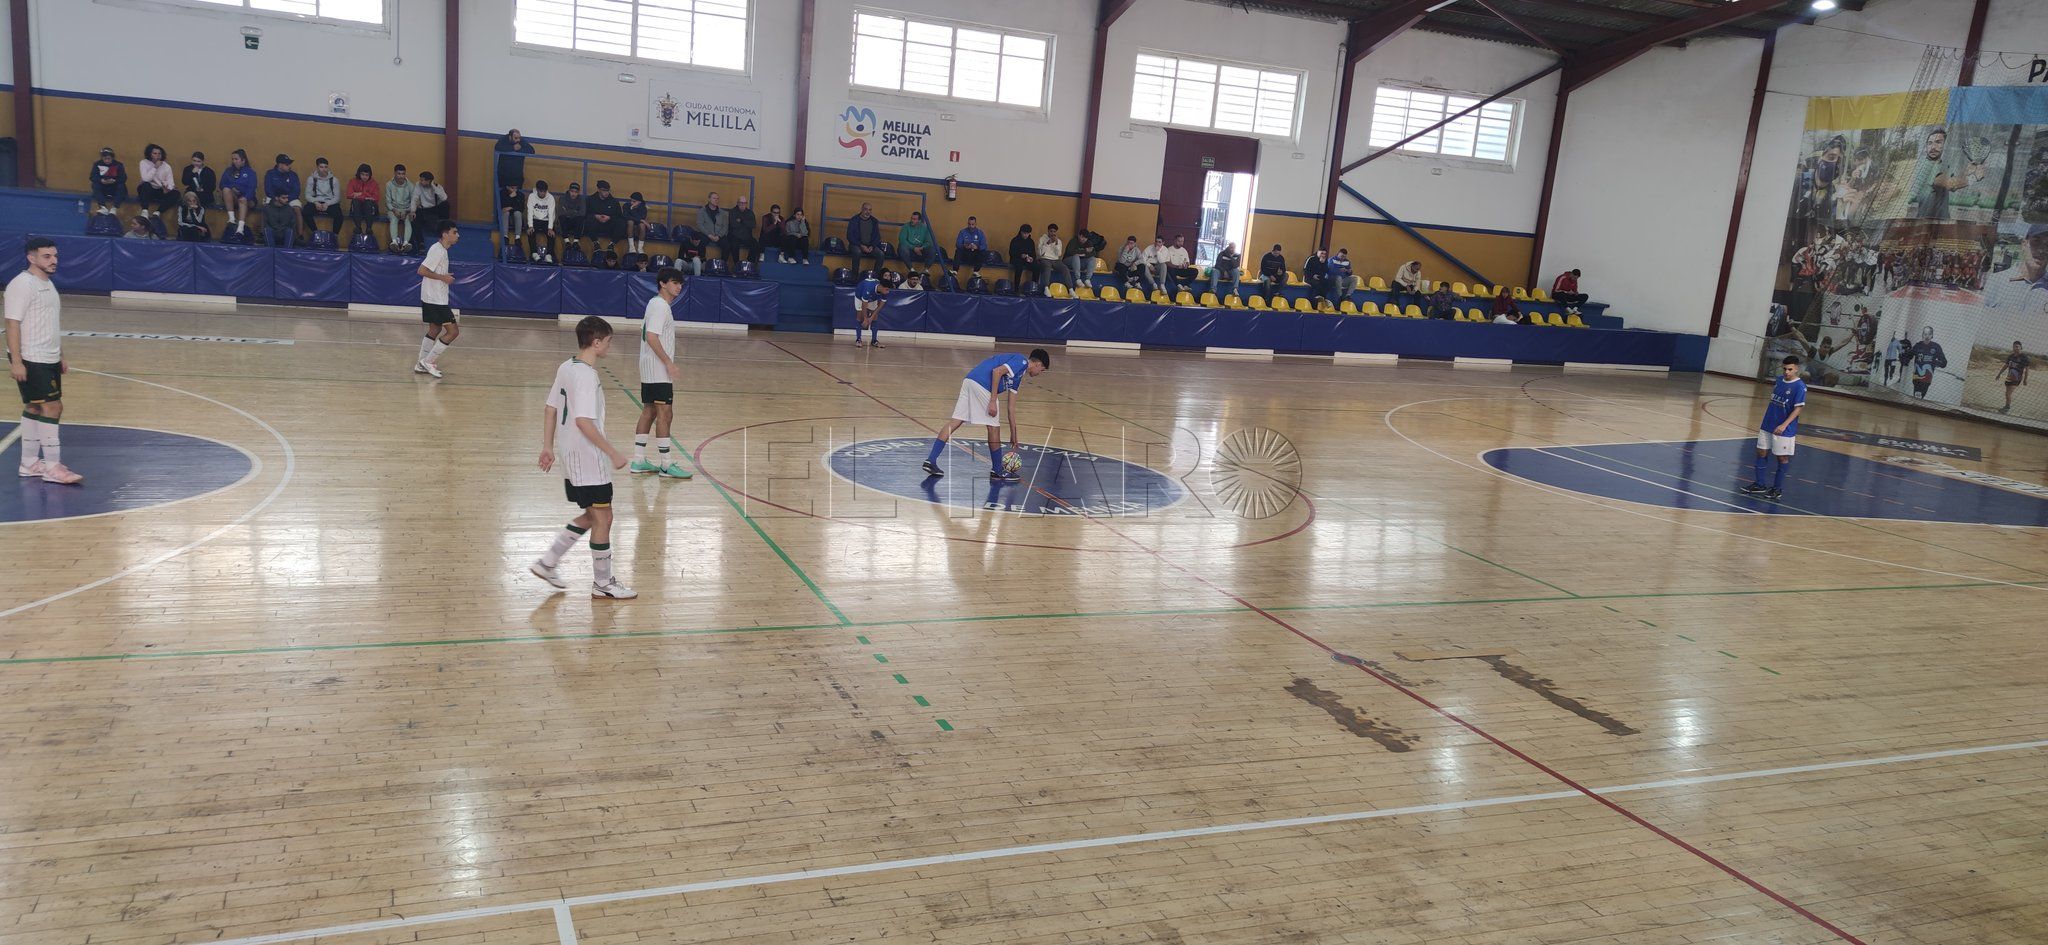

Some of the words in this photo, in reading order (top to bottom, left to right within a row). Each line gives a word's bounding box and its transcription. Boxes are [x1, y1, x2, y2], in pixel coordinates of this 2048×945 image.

[685, 101, 712, 110] CIUDAD
[714, 104, 756, 116] AUTÓNOMA
[686, 110, 756, 132] MELILLA
[882, 120, 931, 136] MELILLA
[882, 132, 922, 147] SPORT
[881, 145, 930, 160] CAPITAL
[983, 501, 1027, 511] DE
